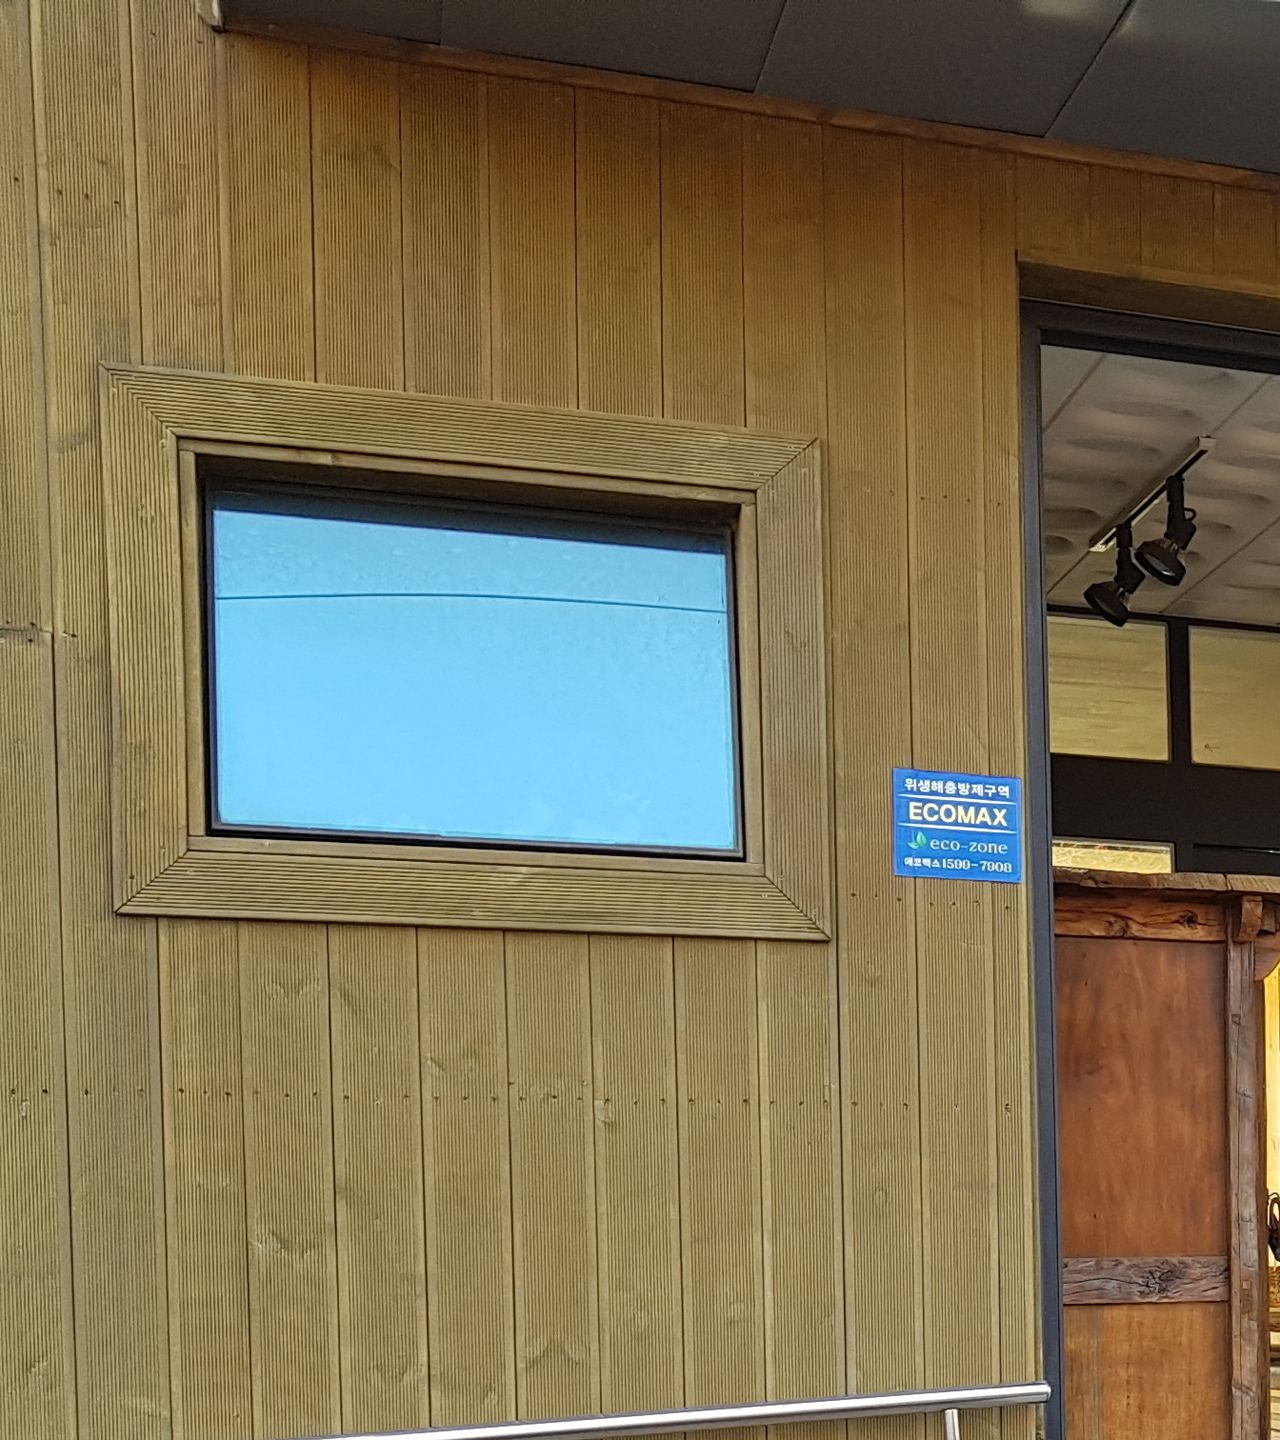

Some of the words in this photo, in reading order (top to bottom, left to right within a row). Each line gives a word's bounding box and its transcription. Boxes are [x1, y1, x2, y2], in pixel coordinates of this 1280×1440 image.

[904, 777, 1010, 799] 위생해충방제구역
[908, 801, 1008, 827] ECOMAX
[929, 837, 1008, 855] eco-zone
